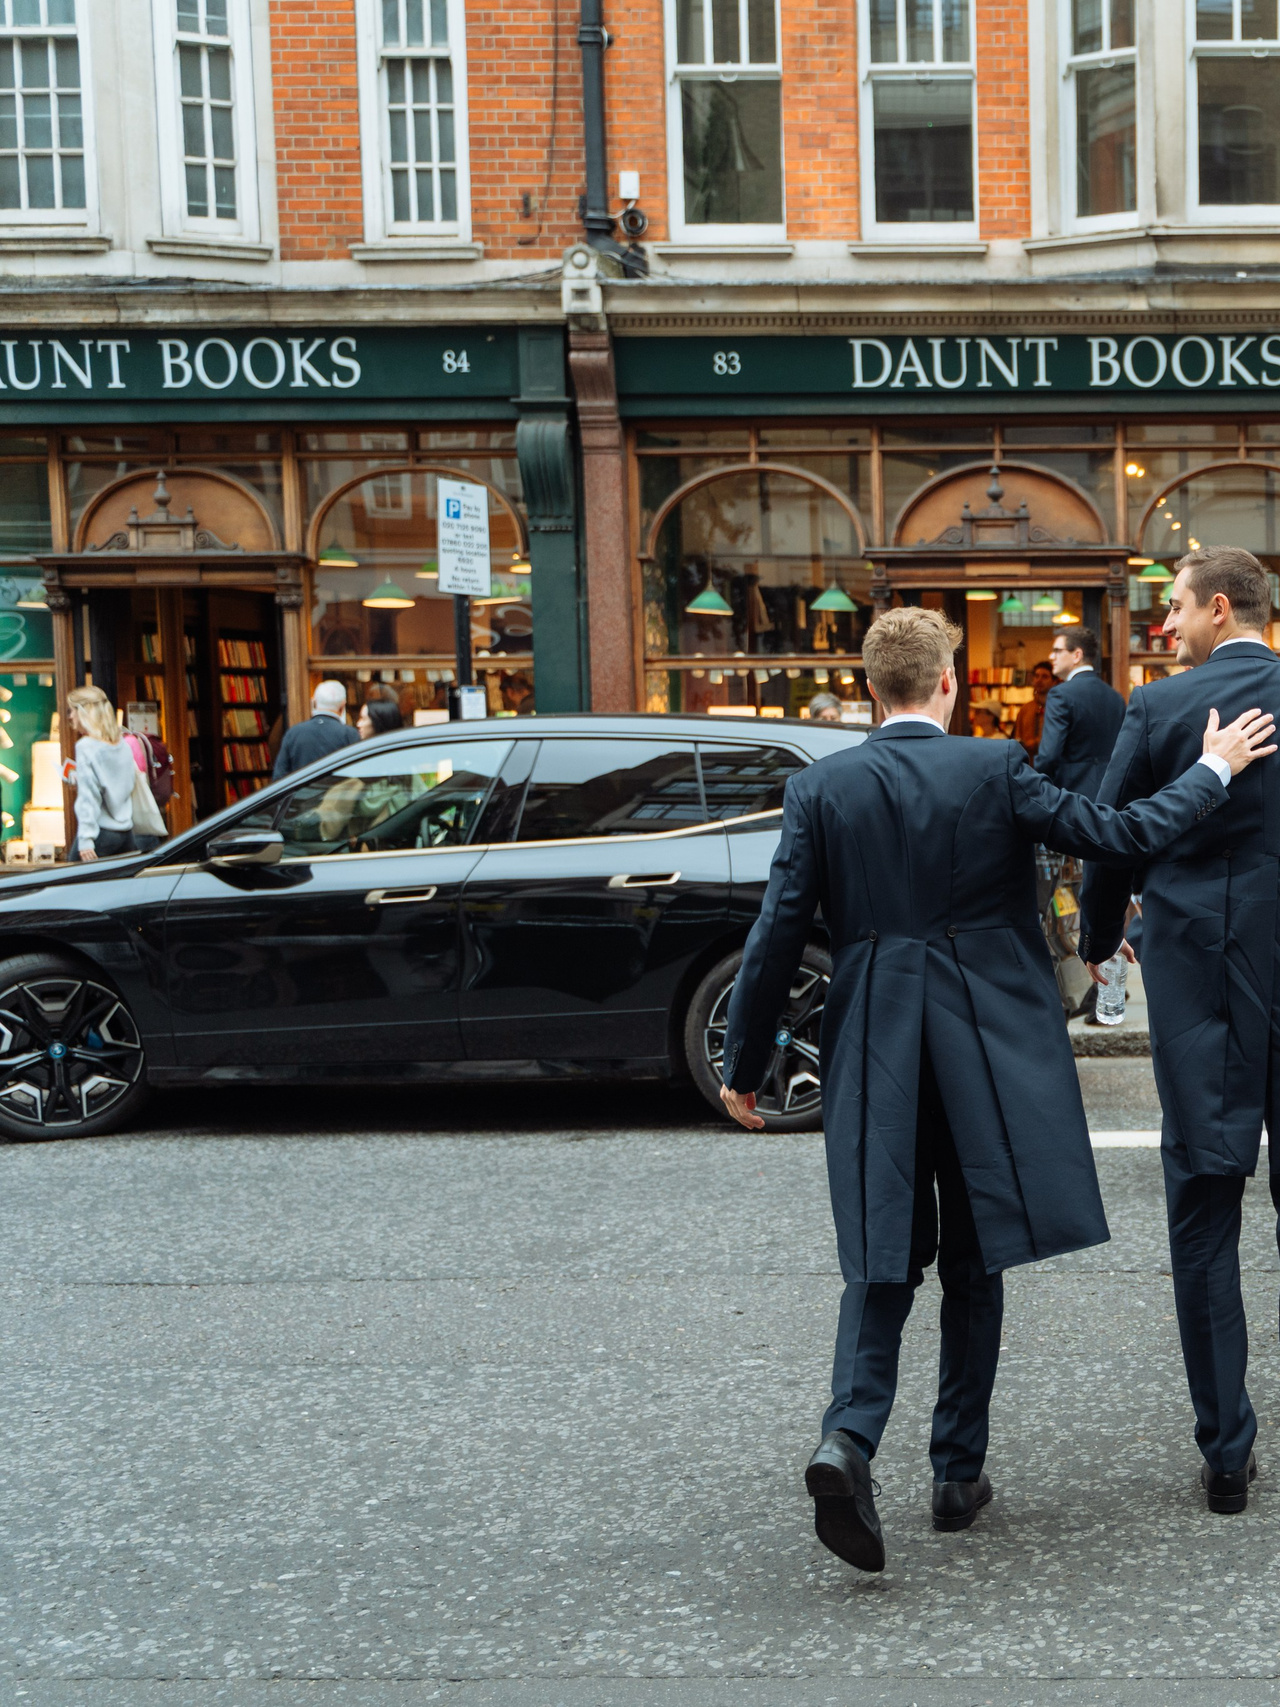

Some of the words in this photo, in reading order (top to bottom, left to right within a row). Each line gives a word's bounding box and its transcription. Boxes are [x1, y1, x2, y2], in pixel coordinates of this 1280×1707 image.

[0, 339, 130, 391] UNT
[157, 337, 362, 390] BOOKS
[442, 349, 470, 373] 84
[713, 351, 742, 375] 83
[848, 338, 1058, 389] DAUNT
